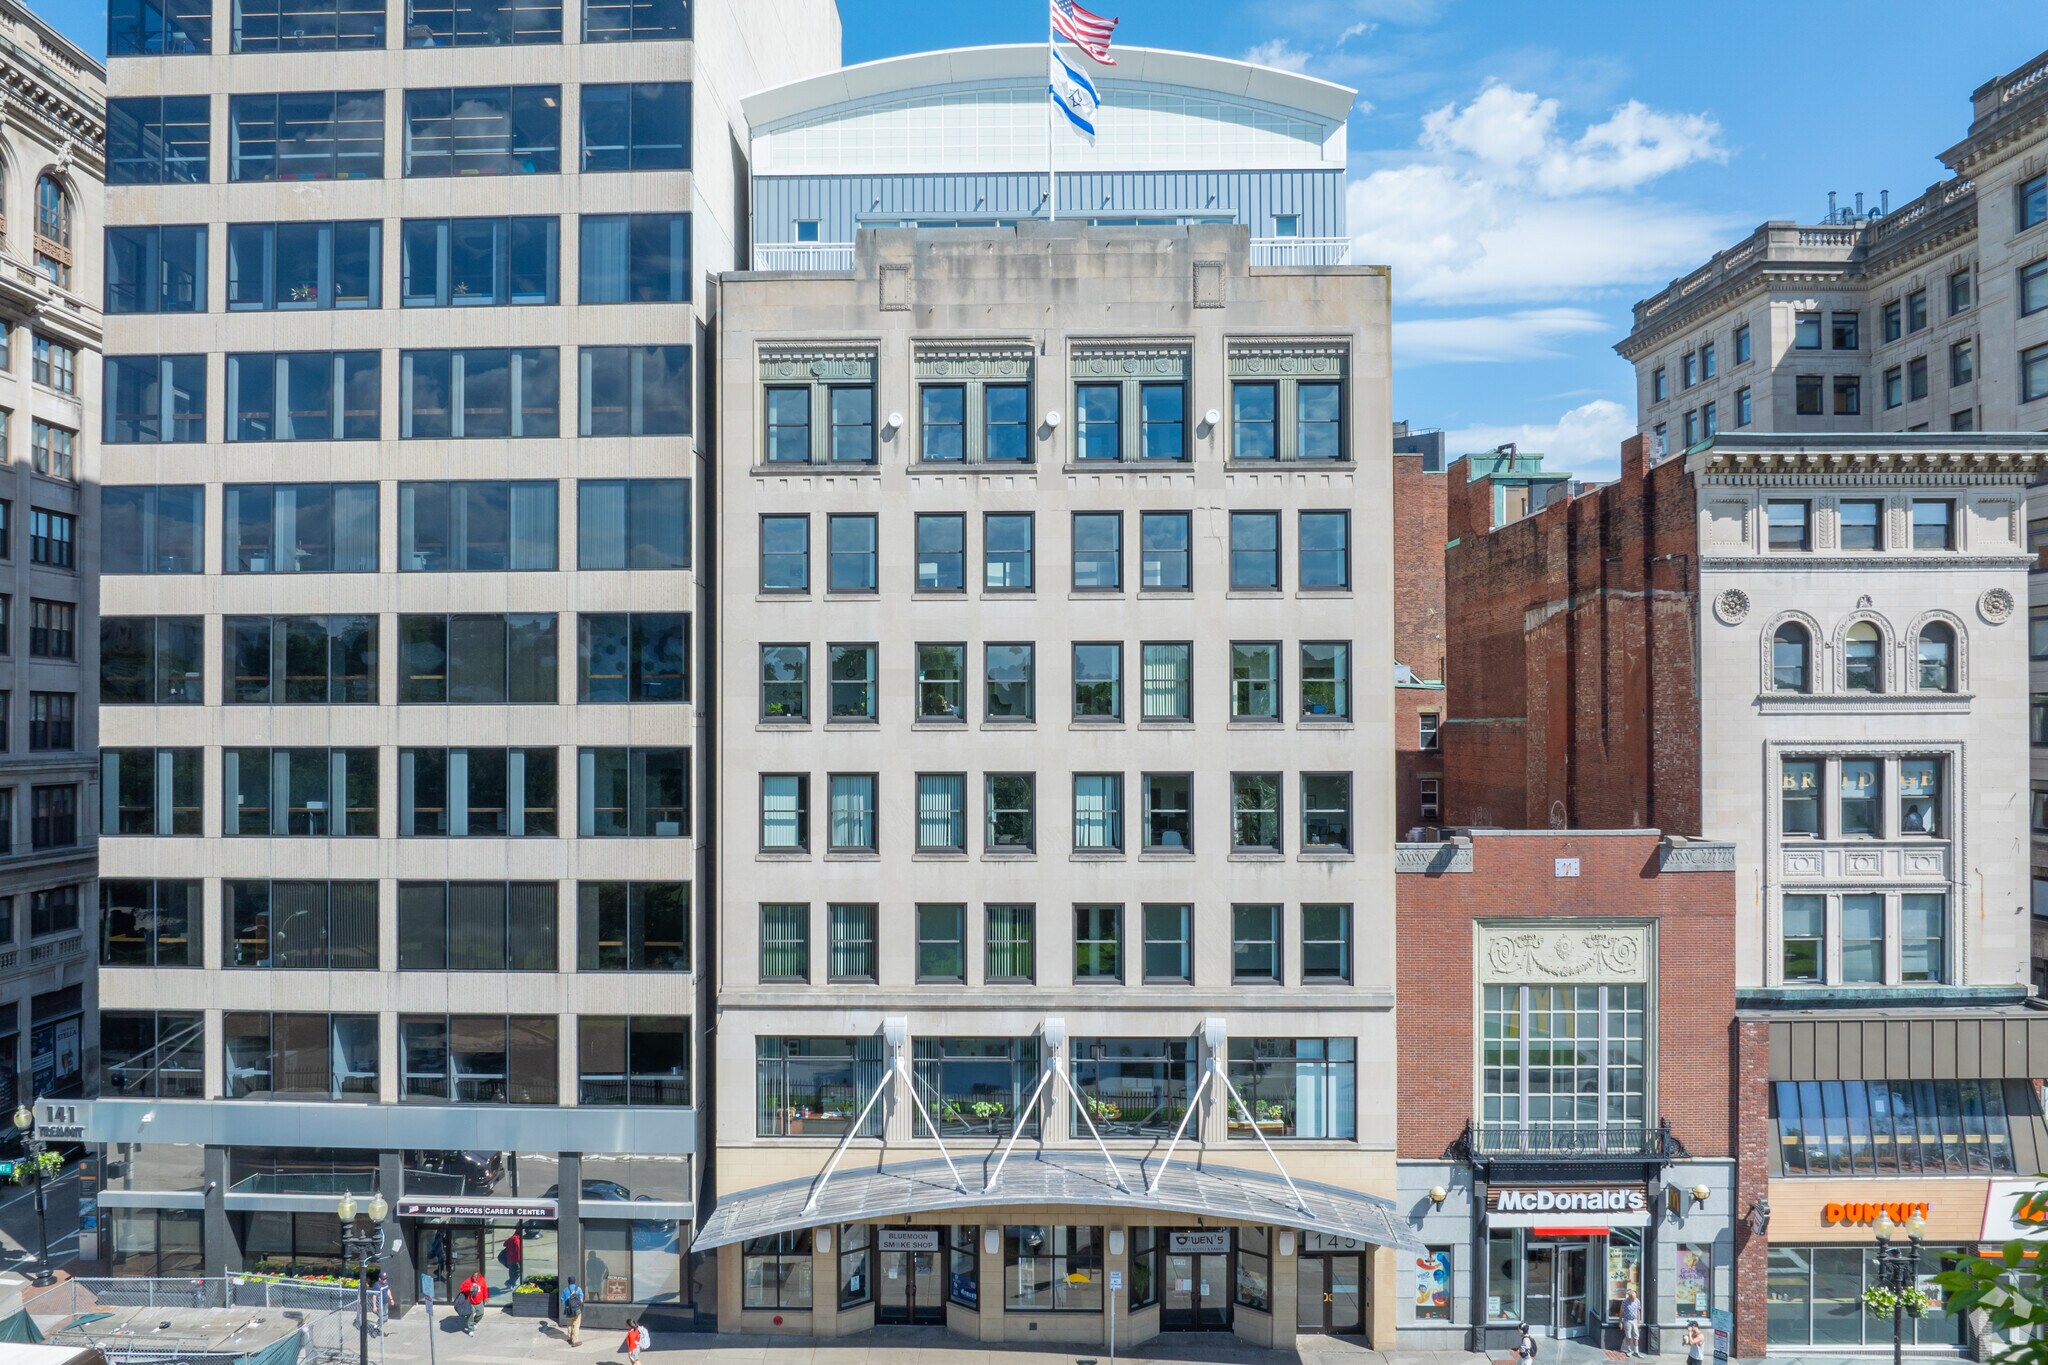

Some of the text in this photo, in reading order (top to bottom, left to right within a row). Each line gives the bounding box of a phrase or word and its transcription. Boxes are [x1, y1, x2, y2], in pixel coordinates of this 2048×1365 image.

[57, 1028, 77, 1041] STELLA
[46, 1106, 76, 1123] 141
[38, 1126, 83, 1138] TREMONT
[1497, 1189, 1644, 1210] McDonald's
[454, 1206, 483, 1214] FORCES
[484, 1207, 514, 1215] CAREER
[1315, 1233, 1356, 1248] 145
